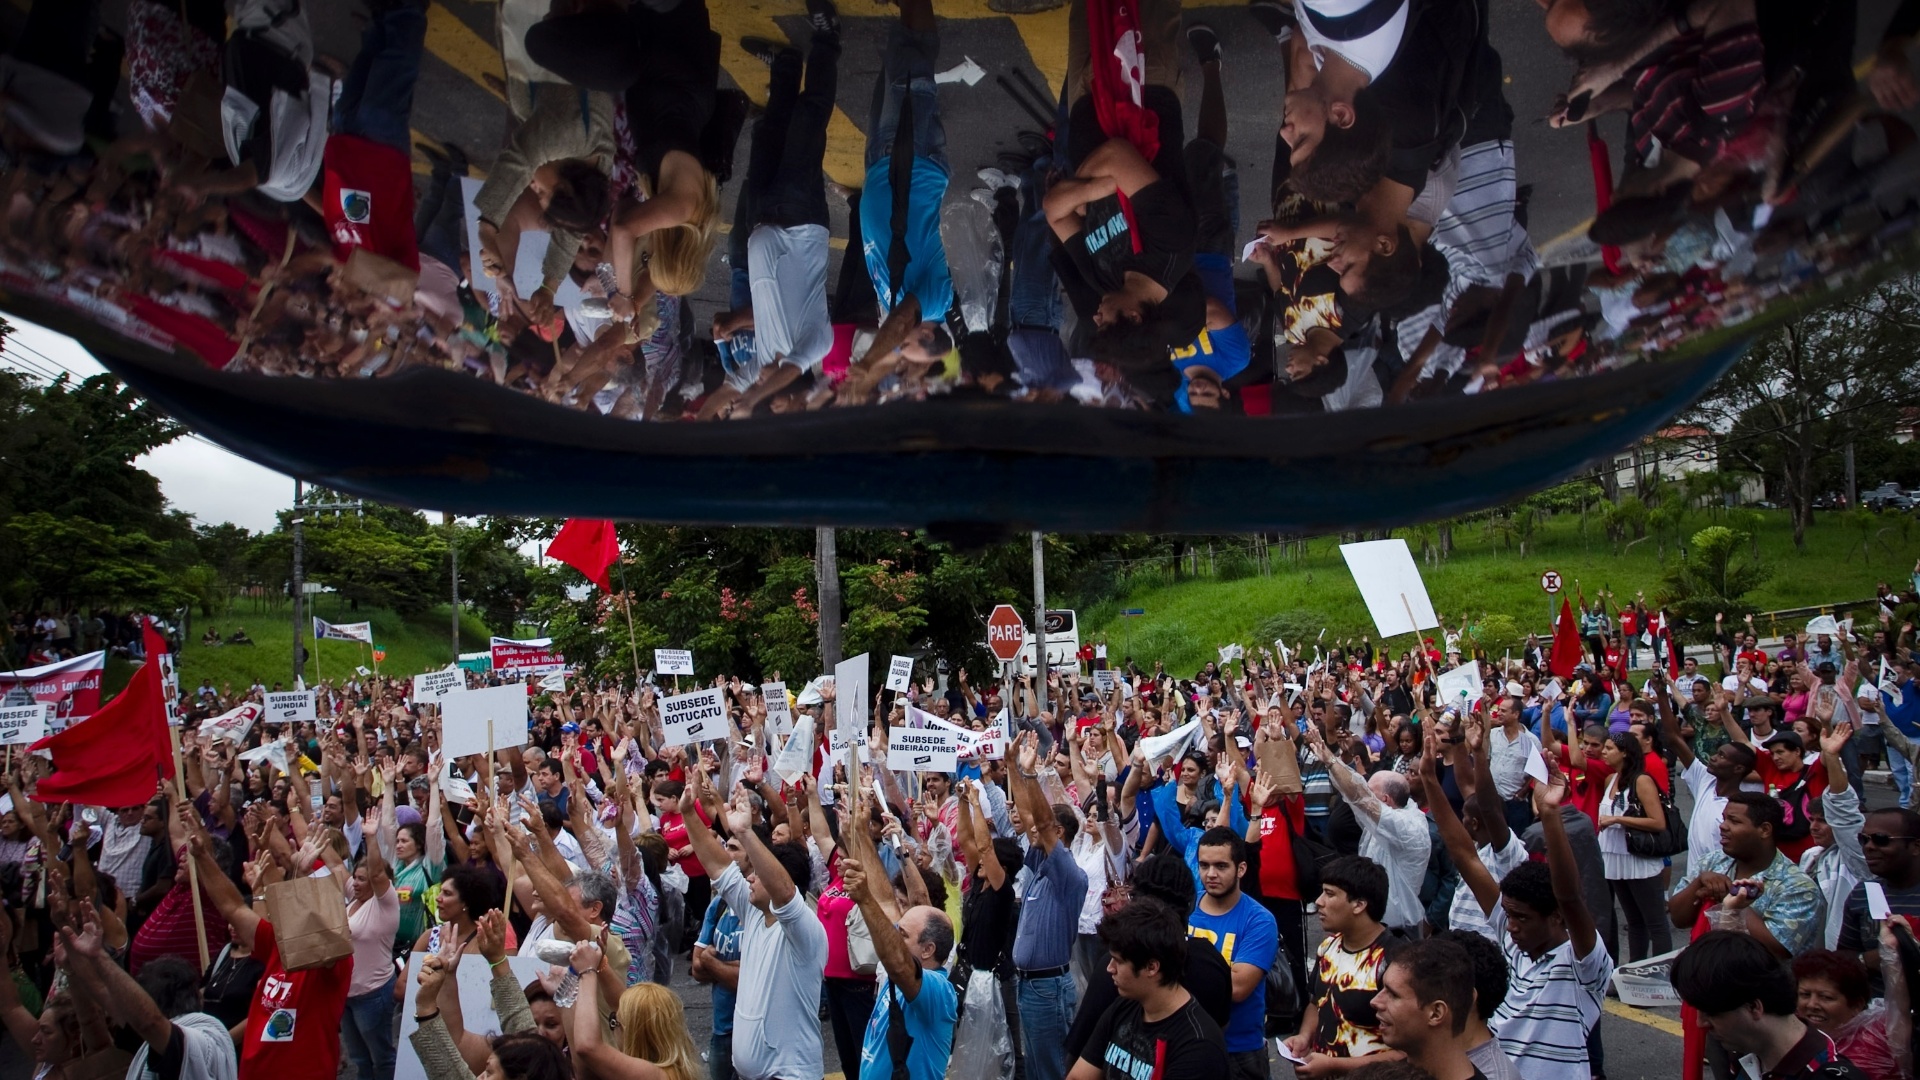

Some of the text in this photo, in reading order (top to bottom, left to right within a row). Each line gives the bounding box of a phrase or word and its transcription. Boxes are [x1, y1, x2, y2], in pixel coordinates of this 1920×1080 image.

[990, 624, 1022, 641] PARE
[425, 672, 455, 680] SUBSEDE
[435, 681, 462, 690] CAMPOS
[270, 694, 309, 703] SUBSEDE
[273, 701, 307, 710] JUNDIAÍ
[666, 695, 716, 713] SUBSEDE
[664, 706, 722, 725] BOTUCATU
[901, 735, 946, 744] SUBSEDE
[890, 743, 930, 752] RIBEIRÃO
[932, 745, 956, 753] PIRES
